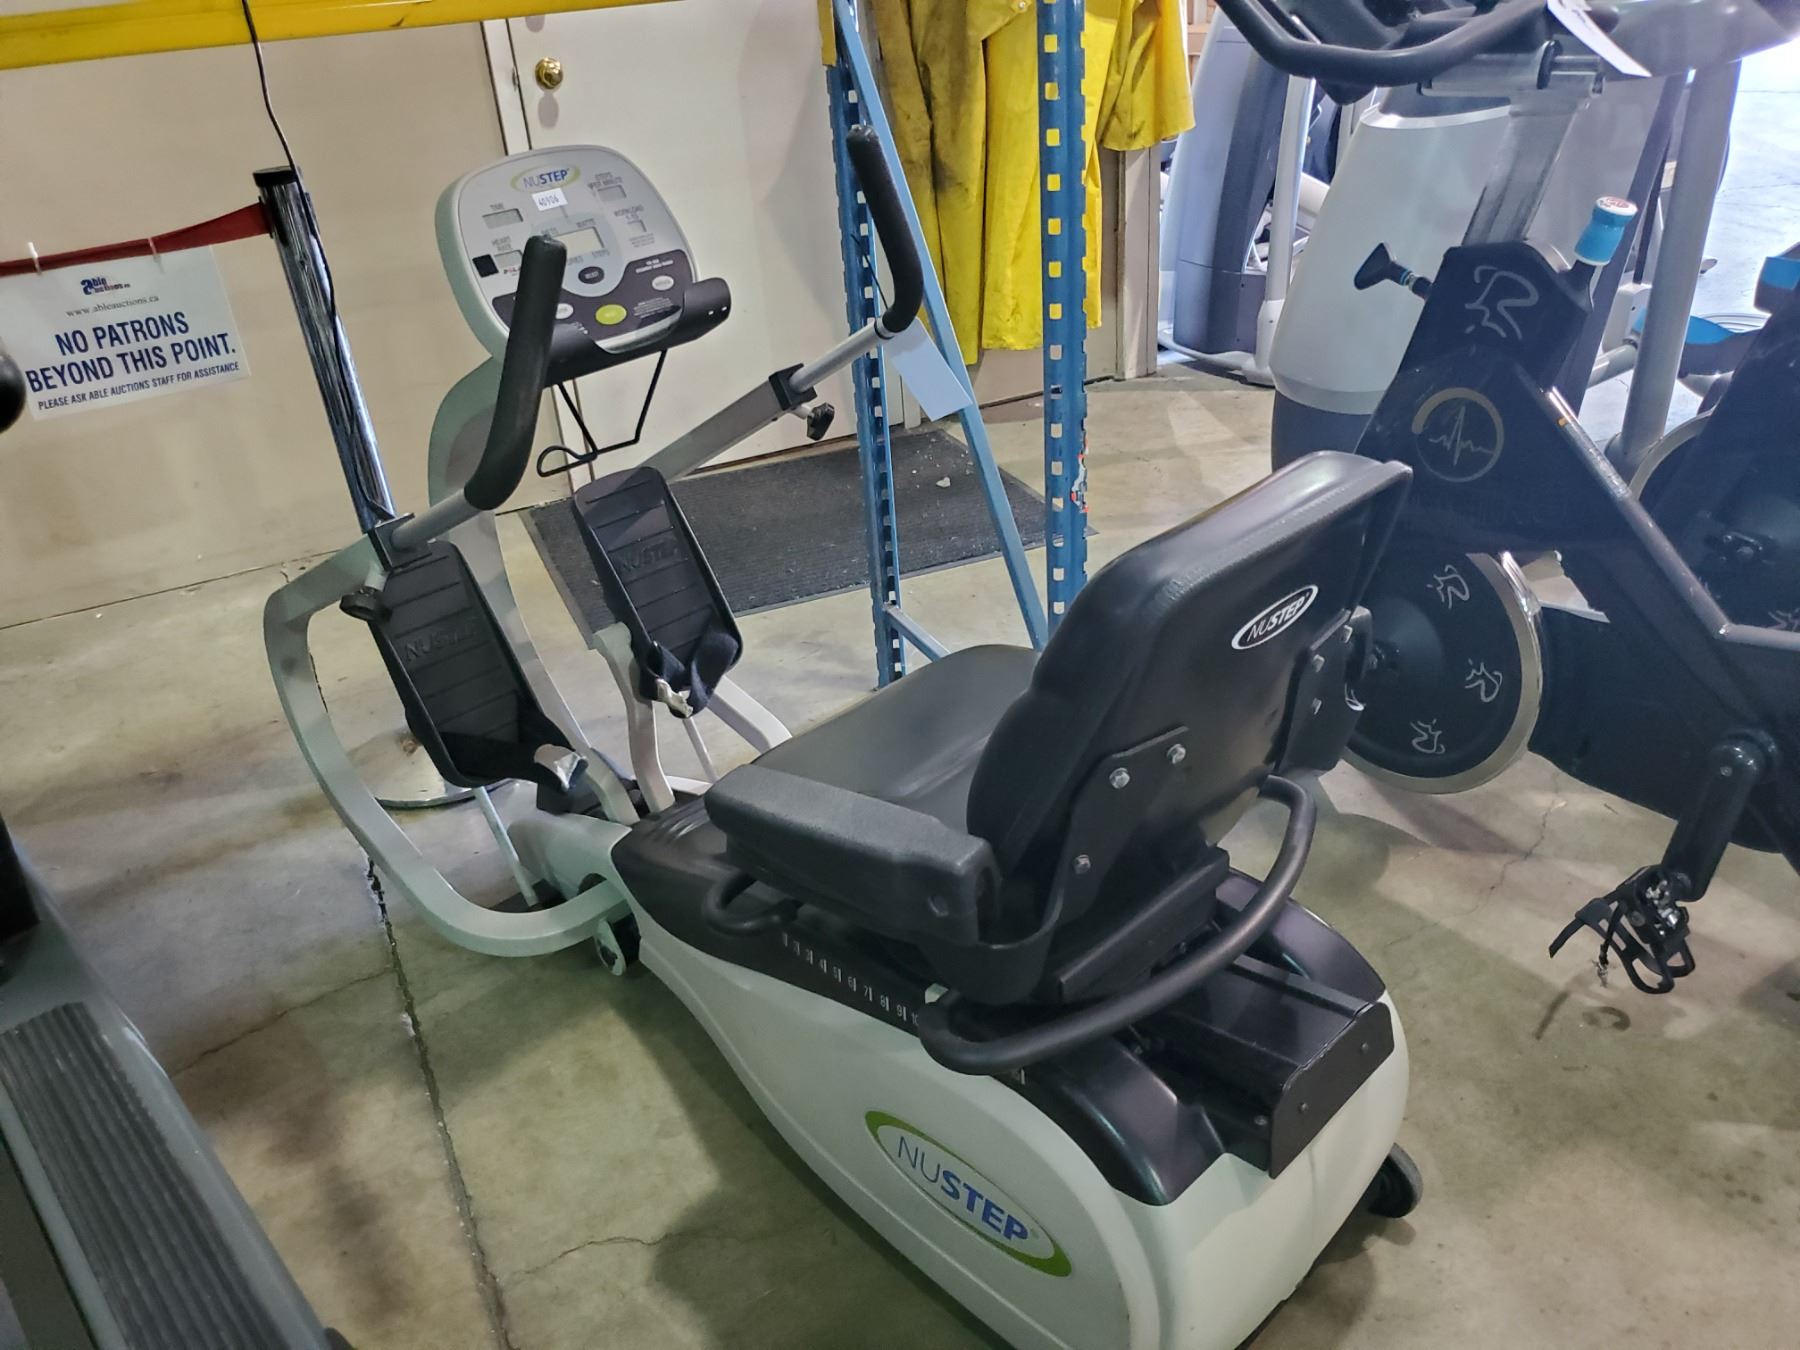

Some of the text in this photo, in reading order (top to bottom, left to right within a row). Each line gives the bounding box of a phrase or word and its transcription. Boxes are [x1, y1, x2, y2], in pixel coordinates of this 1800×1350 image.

[523, 169, 568, 188] NUSTEP
[66, 295, 159, 317] www.ableauctions.ca
[55, 312, 189, 356] NO PATRONS
[25, 333, 236, 393] BEYOND THIS POINT.
[38, 361, 239, 411] PLEASE ASK ABLE AUCTIONS STAFF FOR ASSISTANCE
[1247, 594, 1307, 641] NUSTEP
[898, 1135, 1028, 1241] NUSTEP
